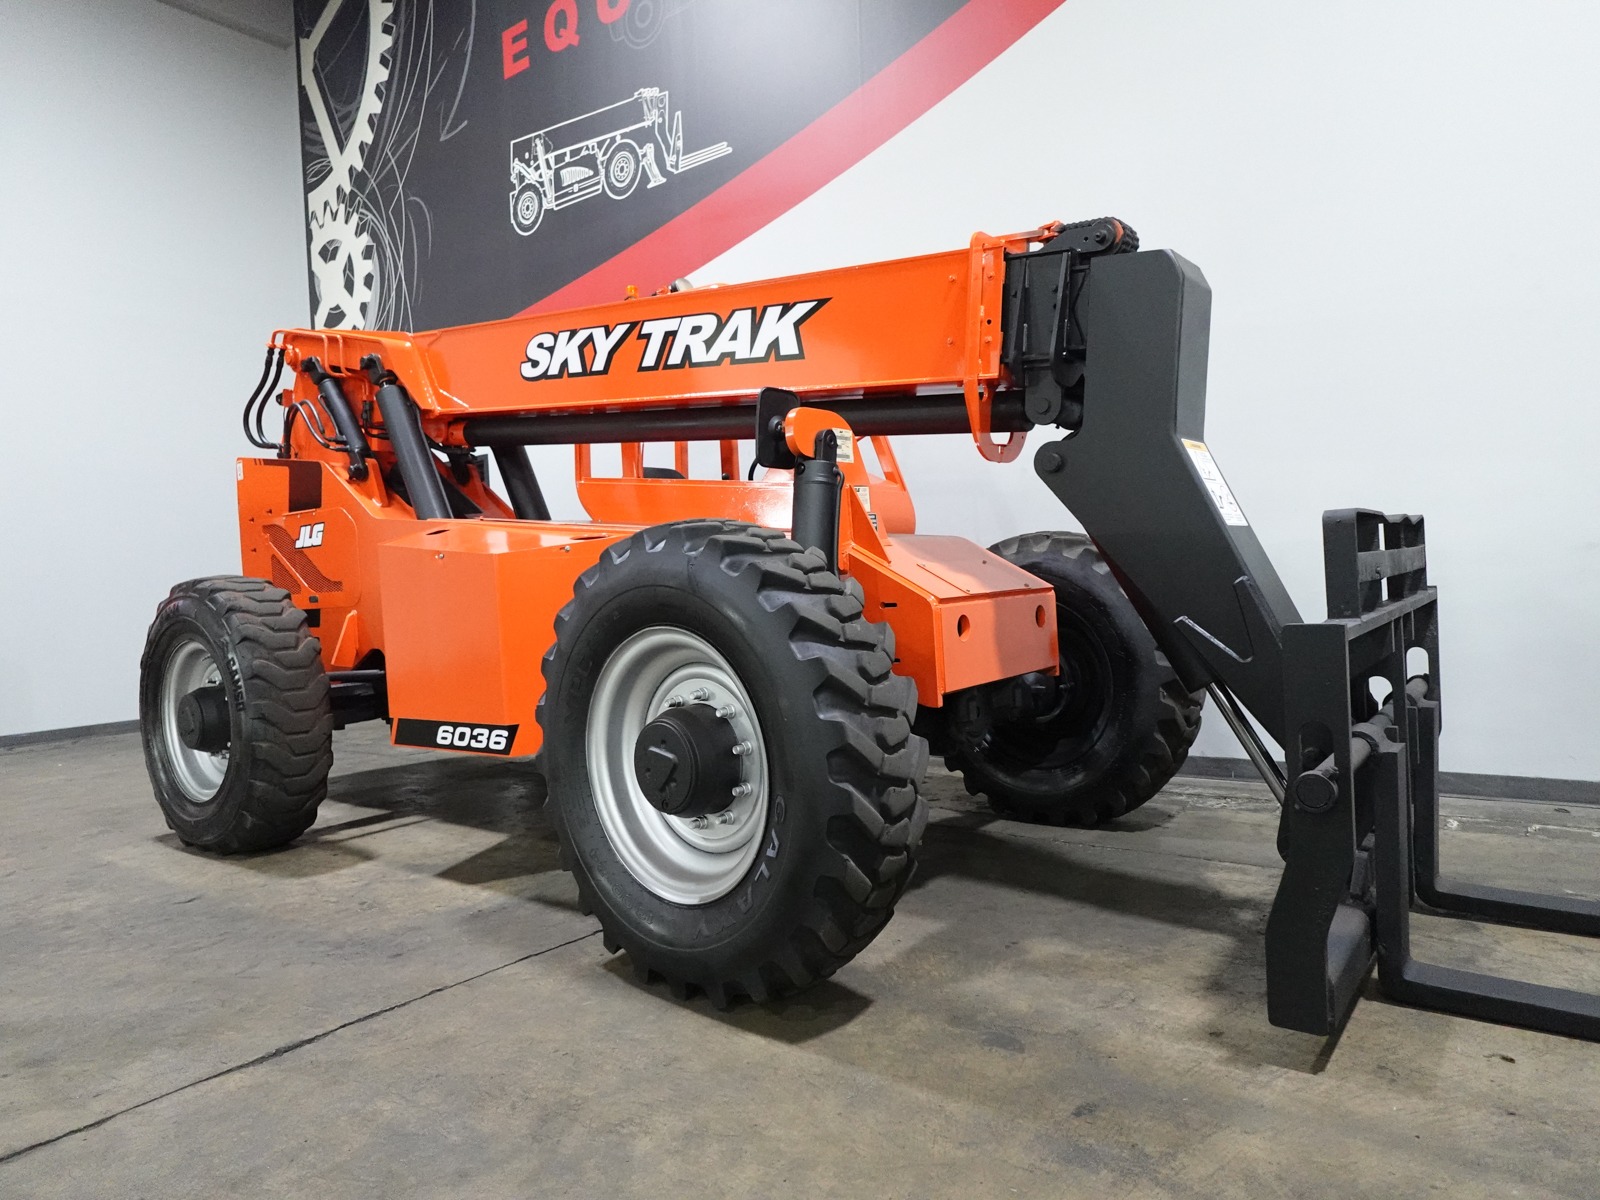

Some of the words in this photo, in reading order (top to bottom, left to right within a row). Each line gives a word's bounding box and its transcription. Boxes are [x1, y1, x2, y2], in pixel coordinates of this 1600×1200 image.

[520, 323, 635, 381] SKY
[638, 298, 828, 372] TRAK
[295, 522, 325, 549] JLG
[436, 725, 509, 750] 6036
